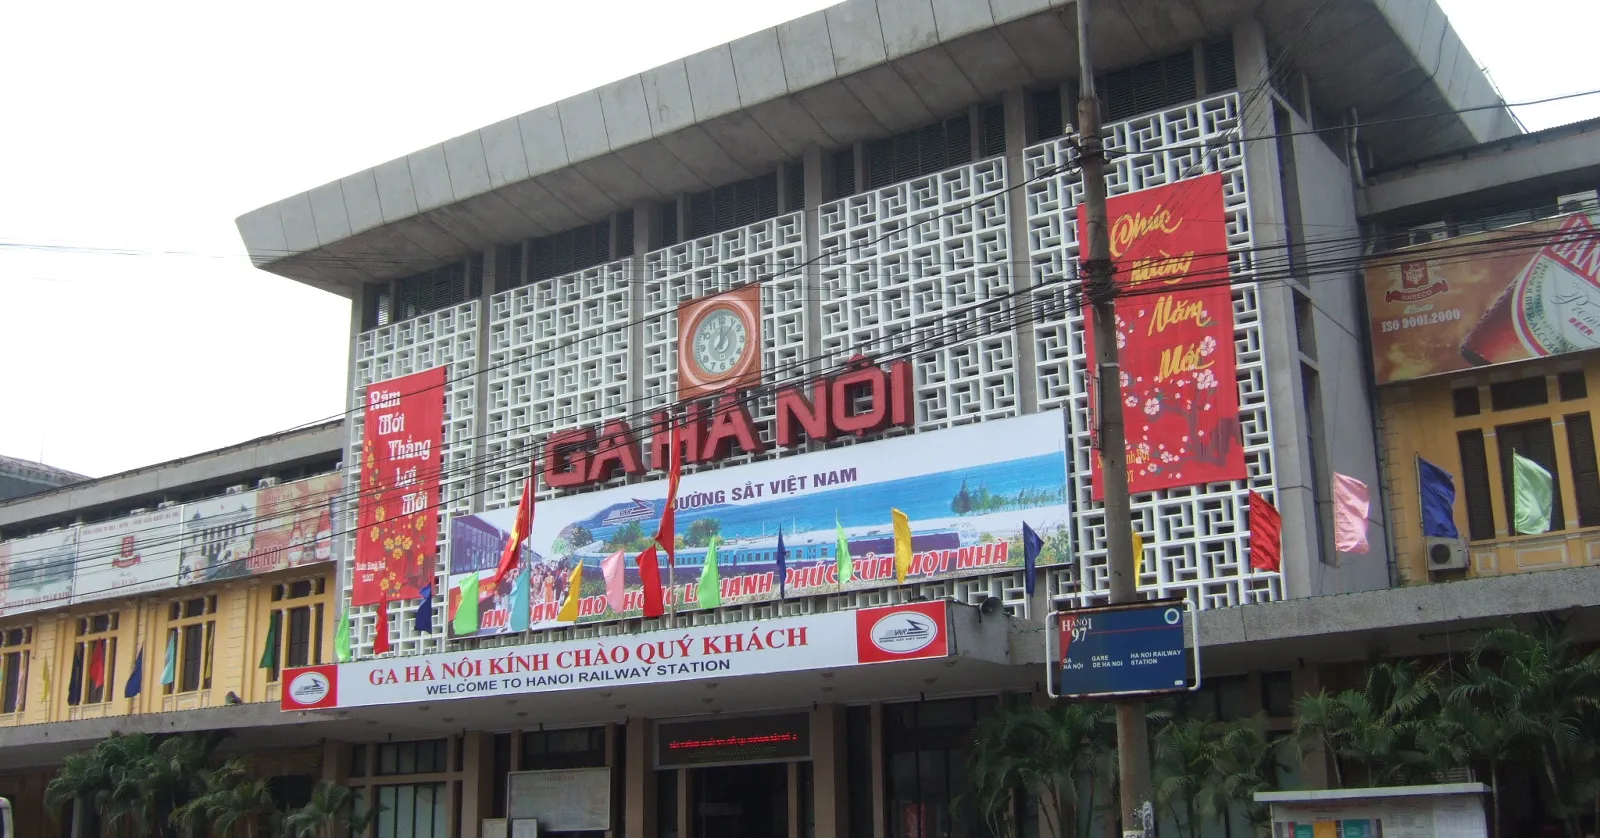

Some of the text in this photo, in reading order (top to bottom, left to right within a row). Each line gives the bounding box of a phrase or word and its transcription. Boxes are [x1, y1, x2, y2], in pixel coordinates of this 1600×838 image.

[1148, 295, 1212, 337] Năm
[1381, 320, 1400, 333] ISO
[1158, 343, 1215, 383] Mới
[378, 412, 405, 436] Mới
[544, 353, 915, 489] GA HÀ NỘI
[388, 434, 431, 461] Thắng
[395, 466, 417, 490] Lợi
[731, 481, 764, 502] SẮT
[770, 475, 808, 495] VIỆT
[813, 467, 857, 488] NAM
[402, 490, 428, 516] Mới
[957, 538, 1009, 570] NHÀ
[1071, 628, 1088, 643] 97
[368, 626, 809, 687] GA HÀ NỘI KÍNH CHÀO QUÝ KHÁCH
[1130, 658, 1158, 666] STATION
[426, 659, 731, 696] WELCOME TO HANOI RAILWAY STATION
